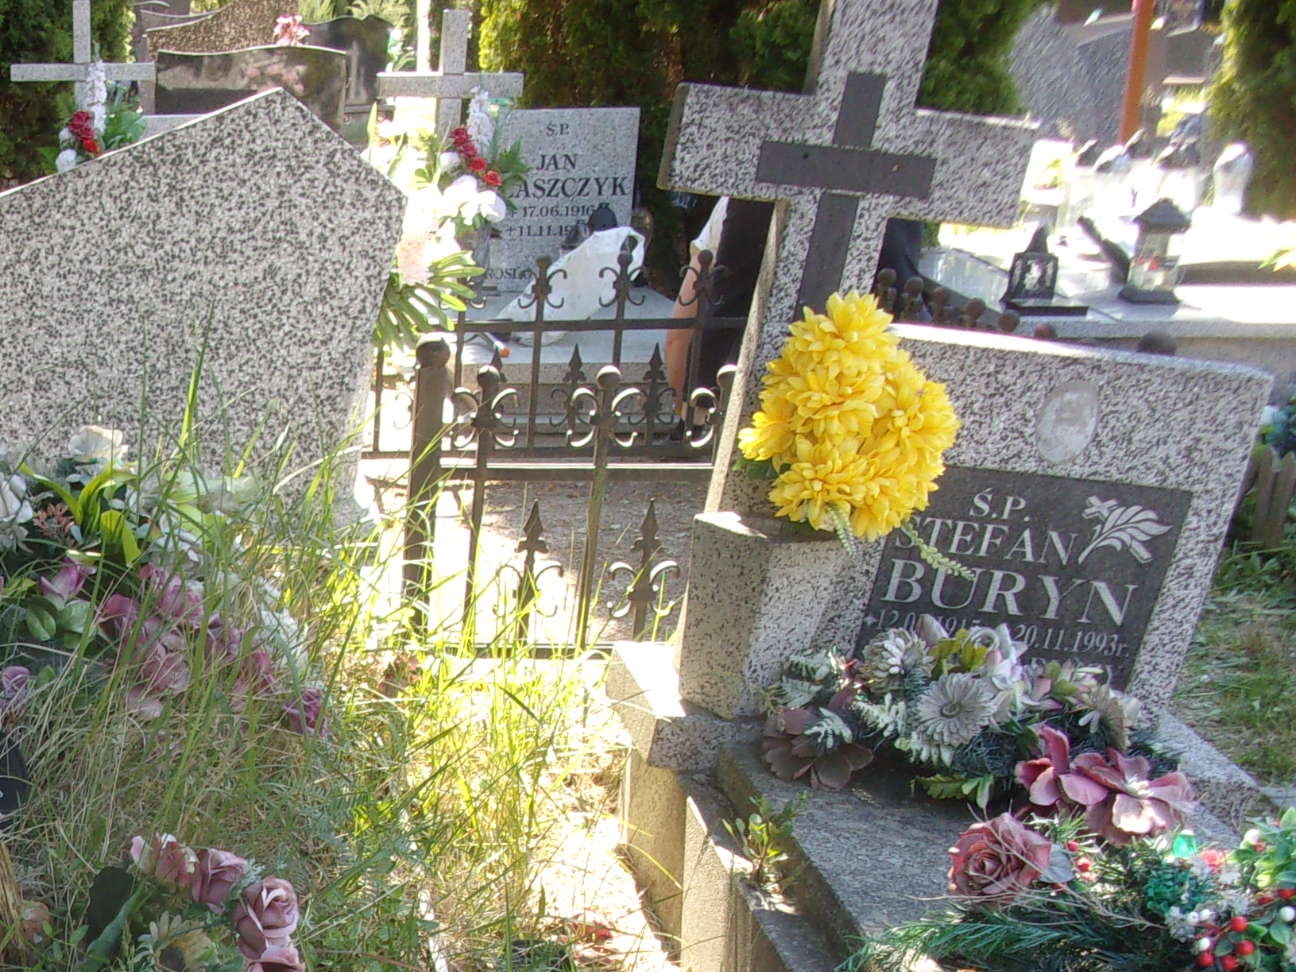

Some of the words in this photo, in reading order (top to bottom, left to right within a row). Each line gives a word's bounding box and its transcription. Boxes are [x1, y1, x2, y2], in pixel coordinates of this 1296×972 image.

[536, 154, 578, 171] JAN
[509, 176, 628, 200] ASZCZYK
[969, 488, 1032, 522] Ś.P.
[894, 517, 1079, 566] STEFAN
[880, 558, 1139, 627] BURYN
